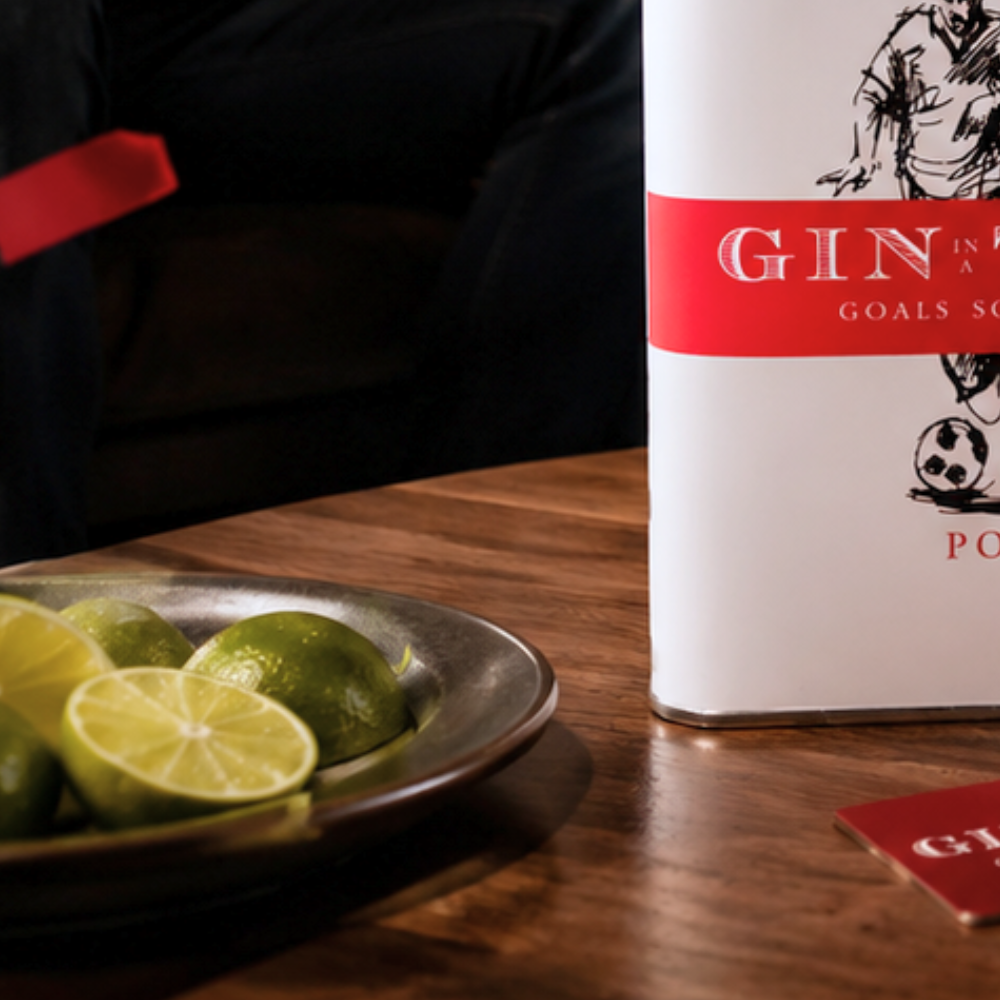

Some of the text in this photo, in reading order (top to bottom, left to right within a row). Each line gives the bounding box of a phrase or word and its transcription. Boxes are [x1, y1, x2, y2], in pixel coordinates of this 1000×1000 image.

[717, 226, 942, 283] GIN
[953, 238, 979, 255] IN
[959, 259, 974, 274] A
[838, 300, 950, 323] GOALS
